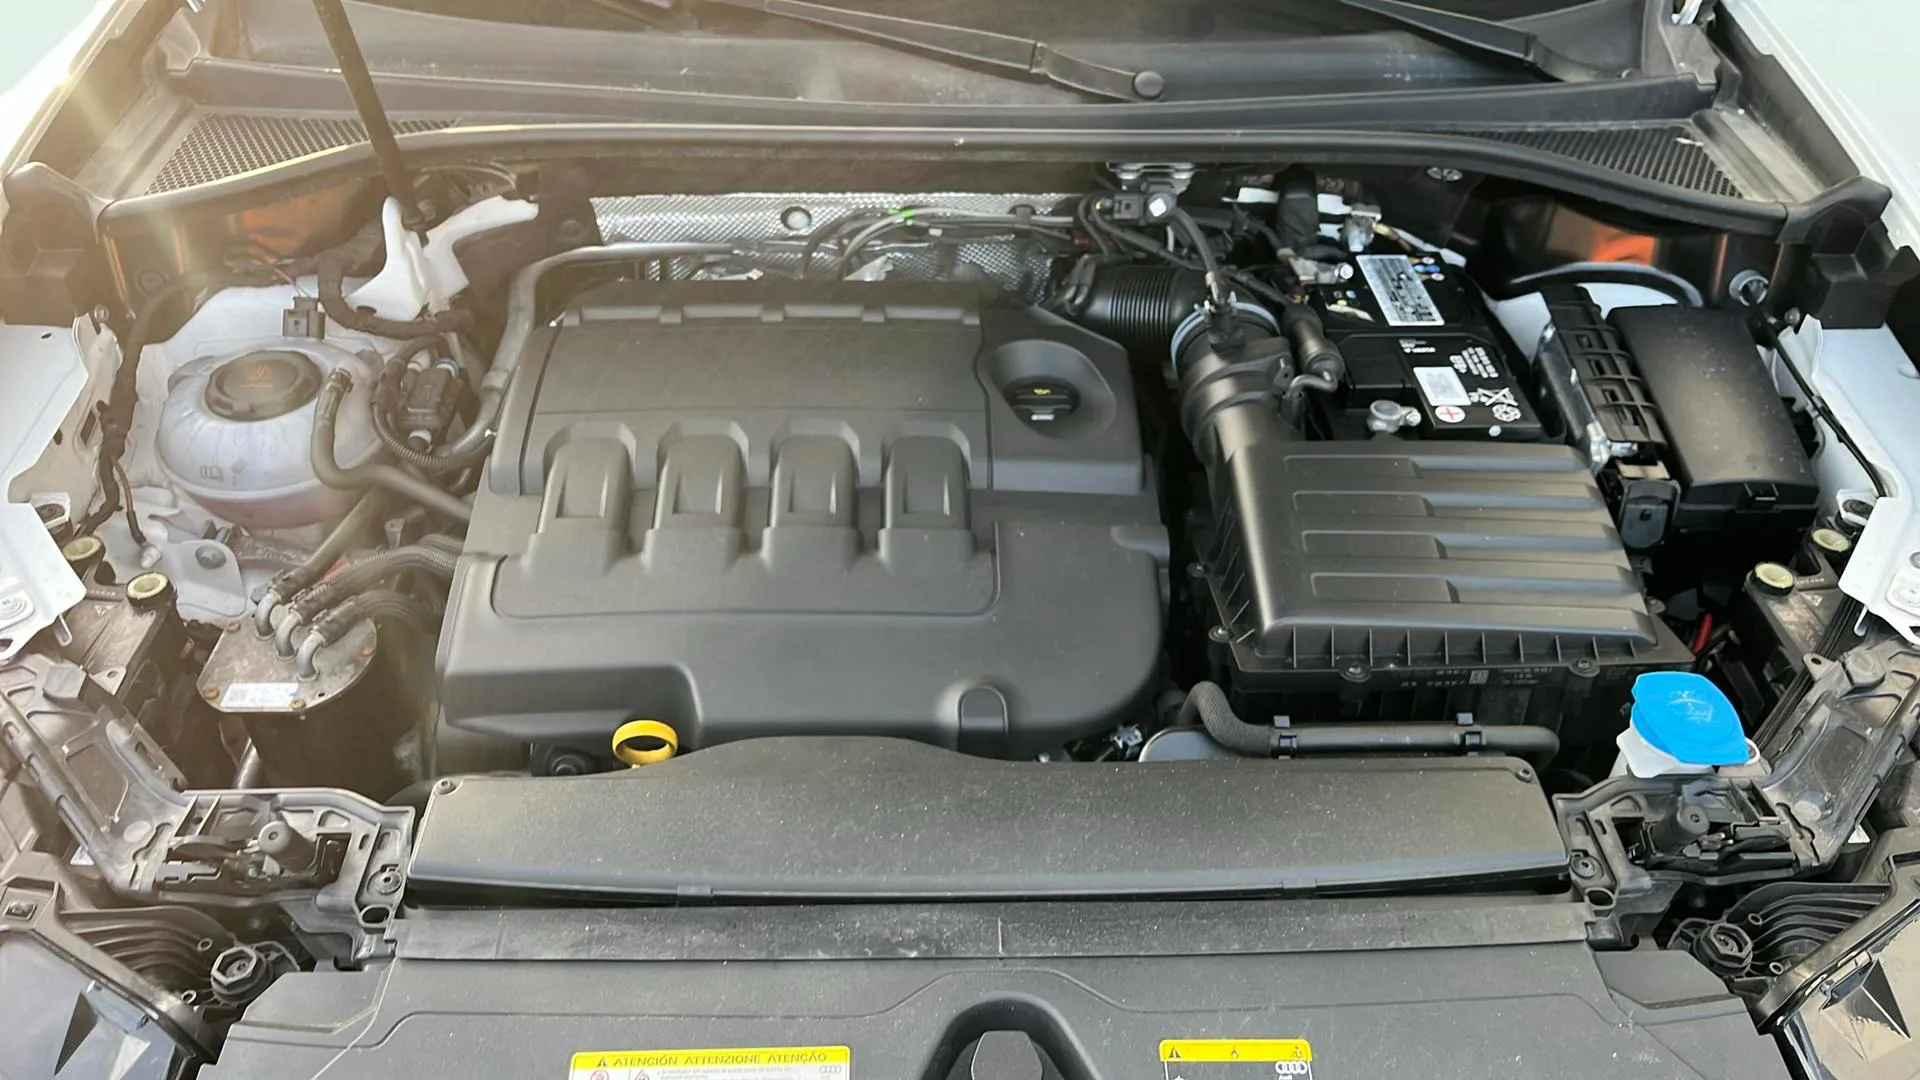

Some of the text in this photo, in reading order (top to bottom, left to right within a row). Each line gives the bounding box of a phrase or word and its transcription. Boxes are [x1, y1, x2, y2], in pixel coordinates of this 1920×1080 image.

[614, 1051, 827, 1067] ATENCIÓN ATTENZIONE ATENÇÃO
